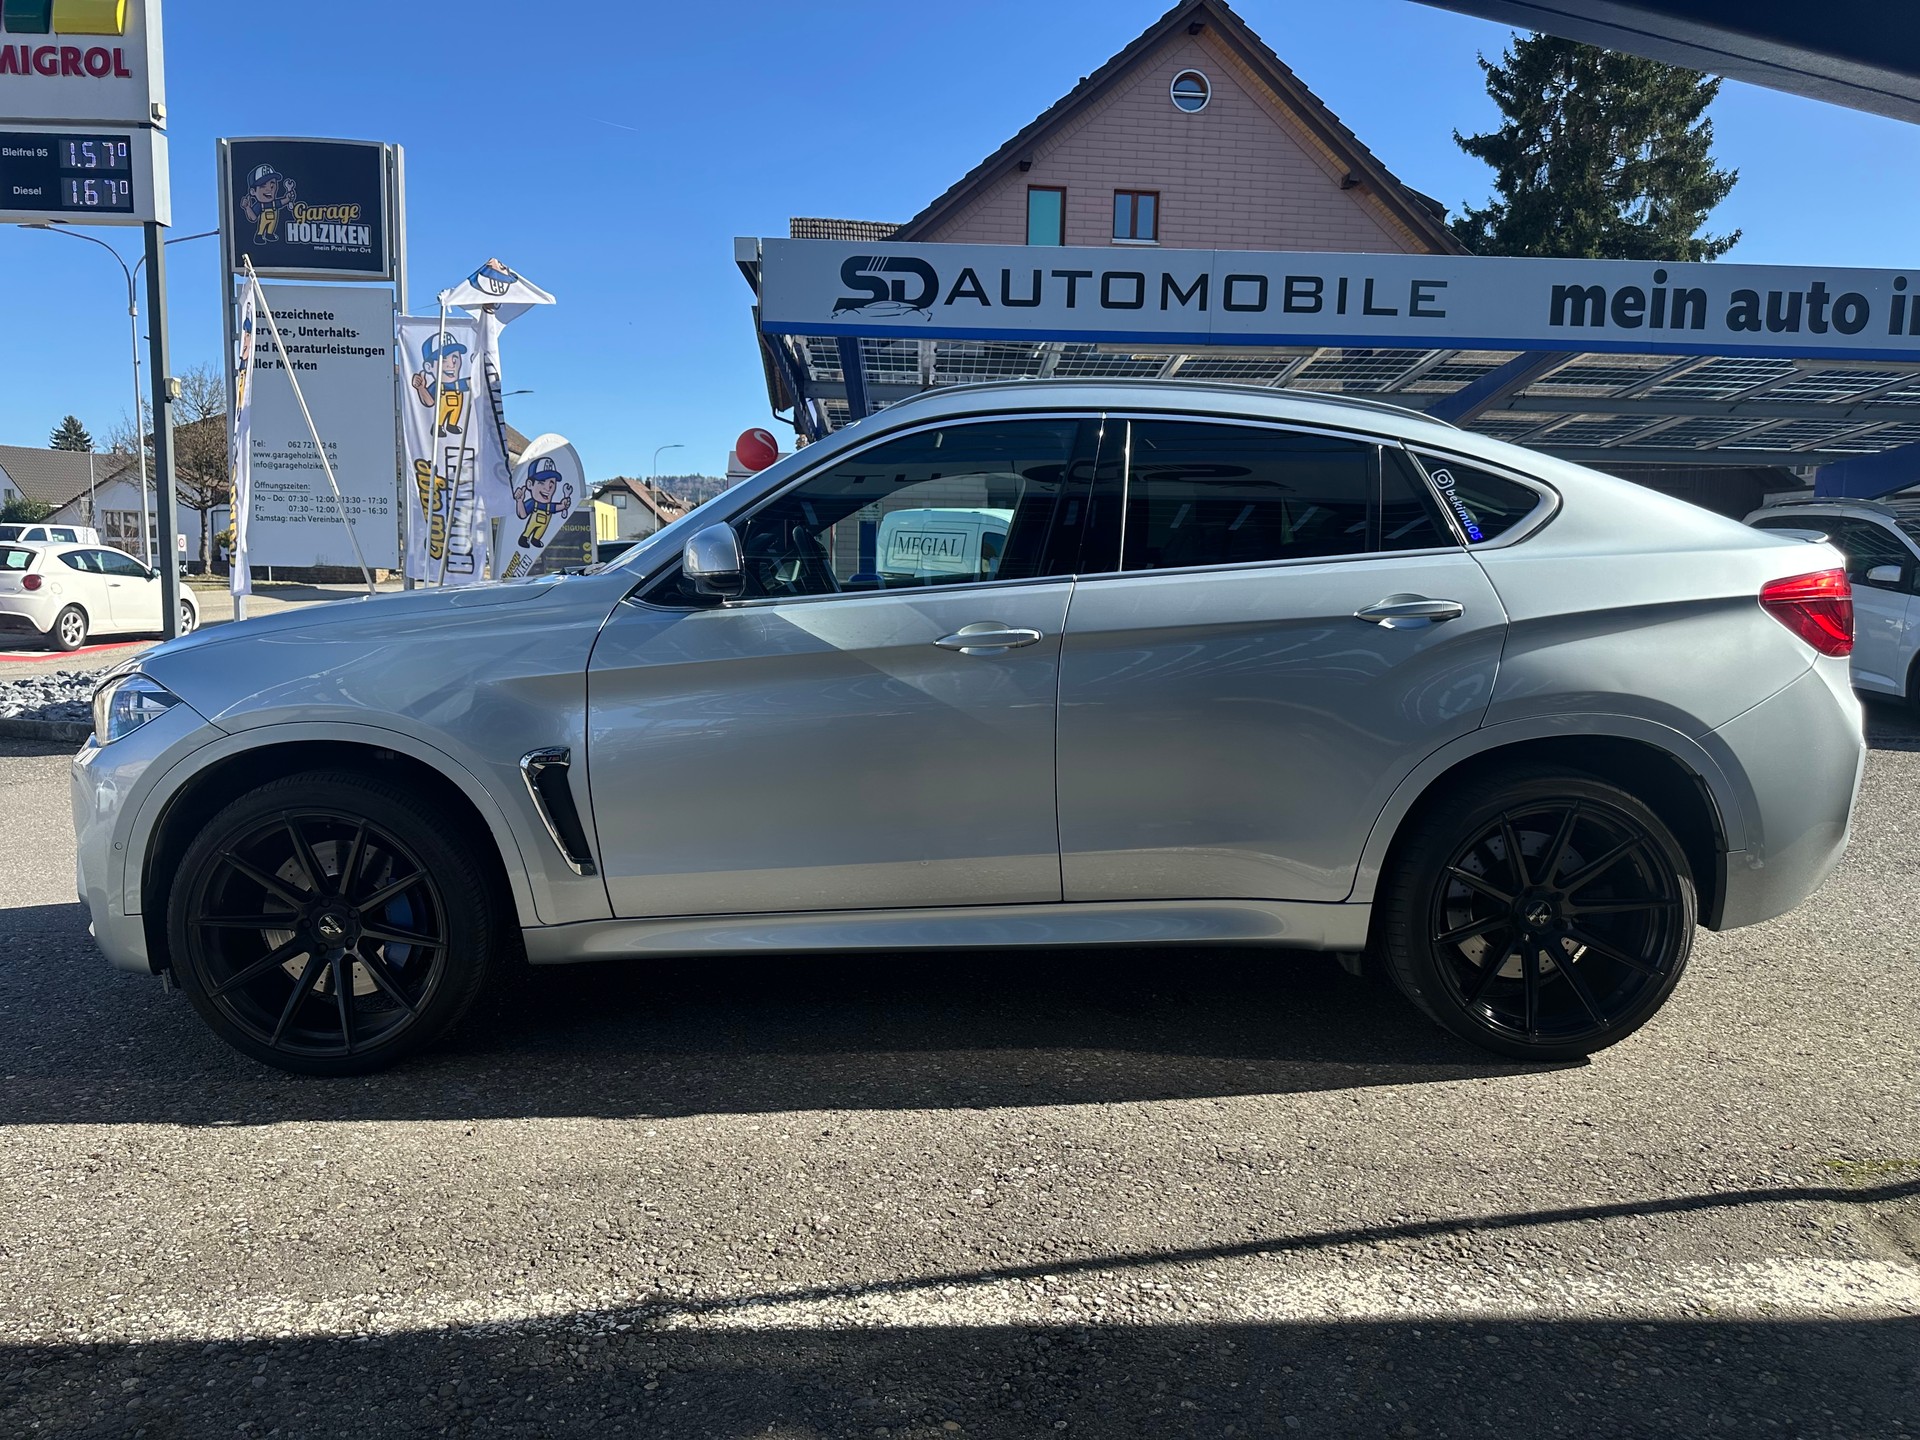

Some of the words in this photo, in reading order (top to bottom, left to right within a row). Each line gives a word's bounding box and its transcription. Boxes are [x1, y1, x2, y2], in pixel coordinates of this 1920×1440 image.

[0, 45, 130, 78] MIGROL
[2, 147, 35, 157] Bleifrei
[36, 148, 48, 157] 95
[13, 186, 42, 195] Diesel
[293, 202, 360, 224] Garage
[287, 222, 370, 245] HOLZIKEN
[943, 266, 1448, 320] AUTOMOBILE
[1549, 268, 1708, 330] mein
[1725, 281, 1870, 335] auto
[255, 309, 334, 321] usezeichnete
[255, 327, 296, 338] ervce-,
[298, 326, 360, 338] Unterhalts-
[254, 341, 269, 352] nd
[271, 342, 385, 358] Rparaturleistungen
[253, 358, 274, 369] ller
[275, 359, 318, 370] Mrken
[252, 439, 266, 448] Tel:
[287, 441, 301, 449] 062
[303, 441, 315, 449] 721
[252, 452, 338, 460] www.garageholzik.ch
[253, 460, 339, 470] info@garageholzikech
[254, 480, 311, 491] Öffnungszeiten:
[254, 494, 266, 502] Mo
[273, 494, 285, 502] Do:
[288, 495, 309, 503] 07:30
[341, 496, 361, 504] 13:30
[368, 497, 388, 505] 17:30
[368, 507, 388, 515] 16:30
[255, 514, 288, 523] Samstag:
[290, 514, 307, 523] nach
[897, 536, 960, 557] MEGIAL
